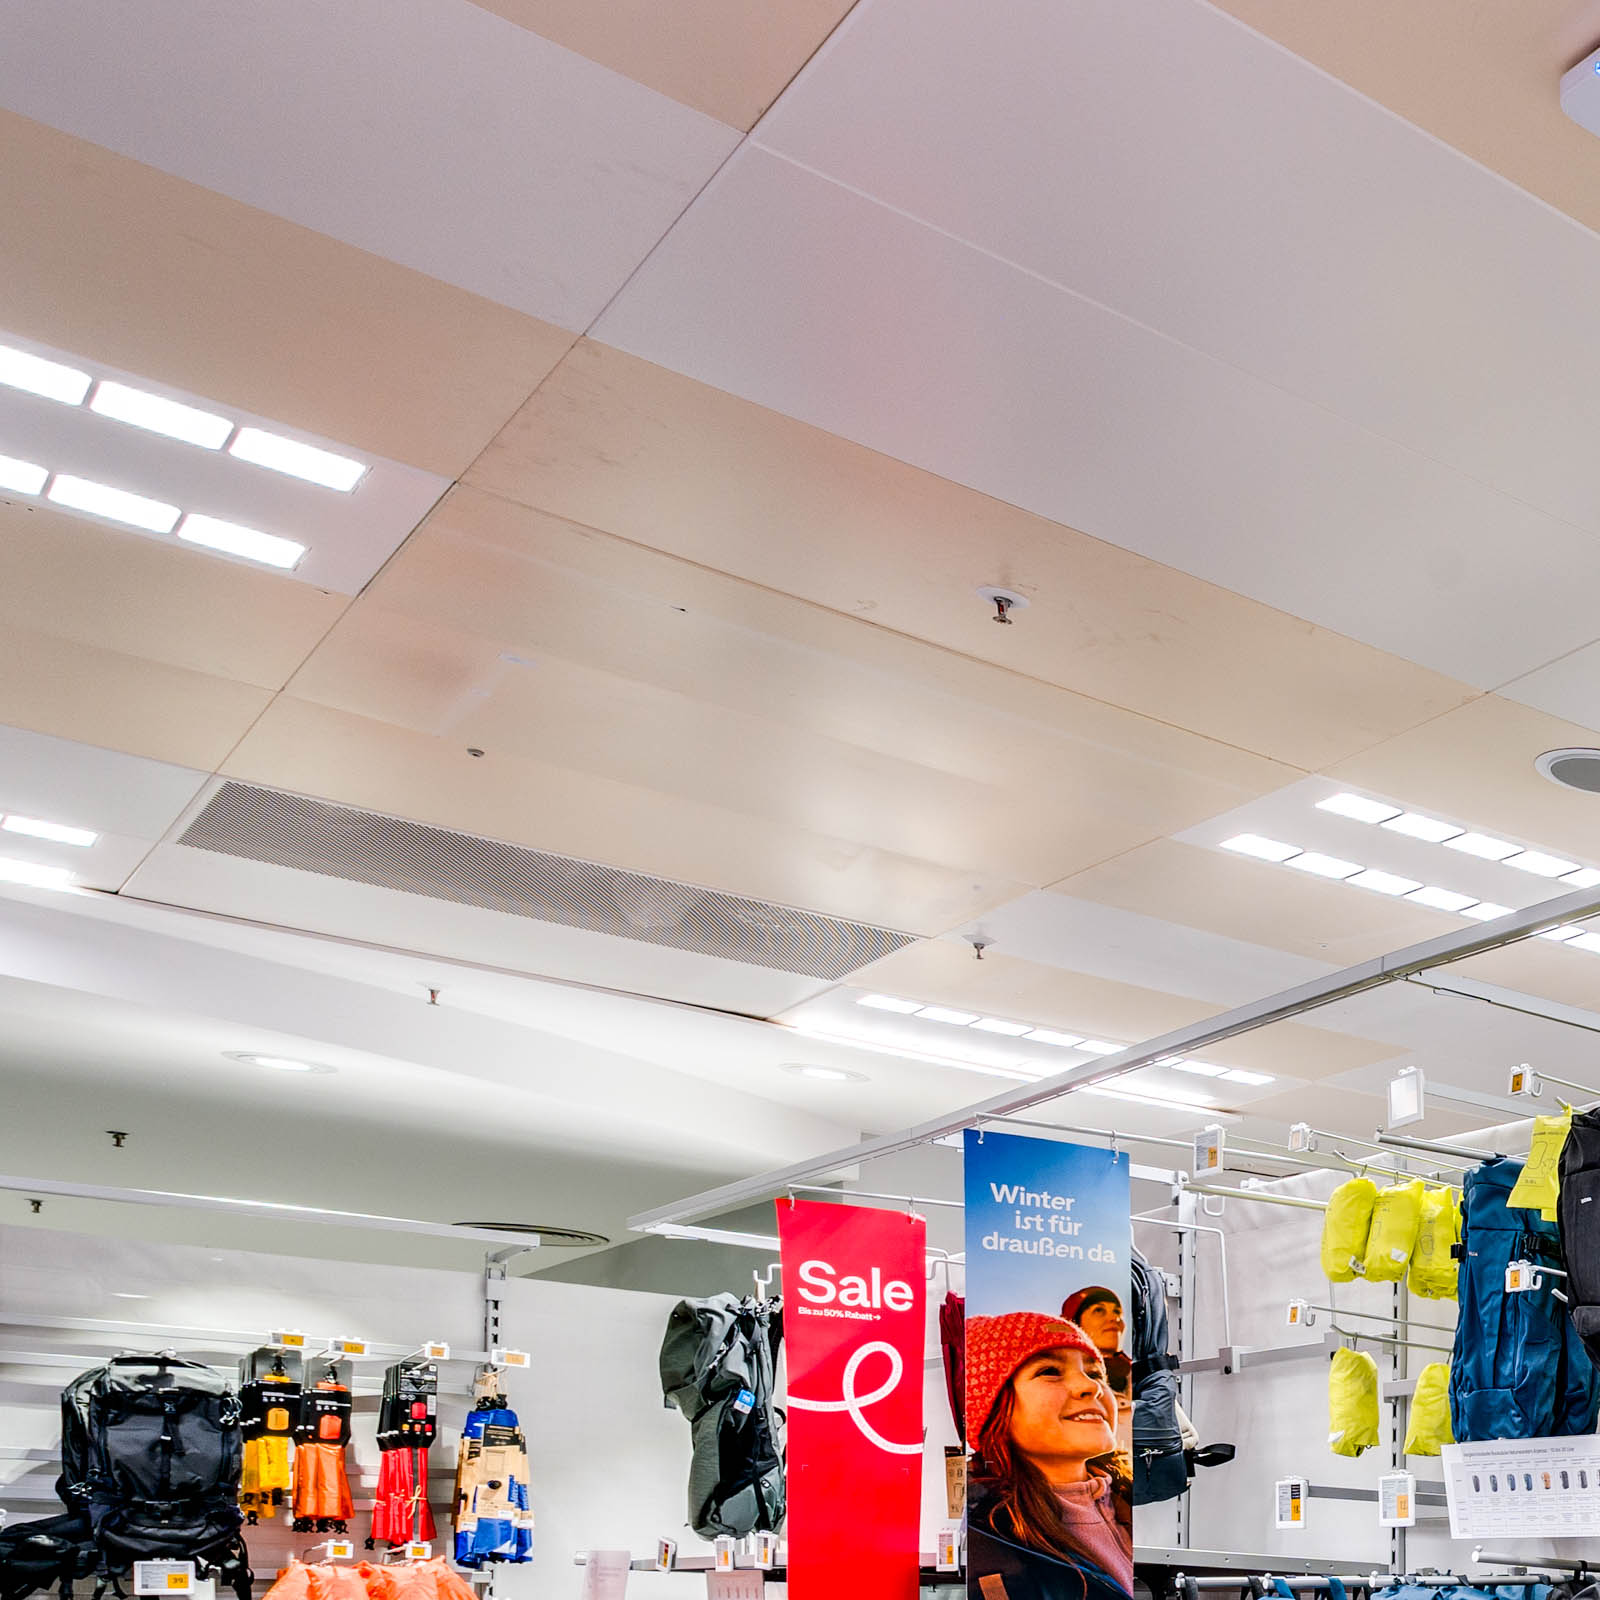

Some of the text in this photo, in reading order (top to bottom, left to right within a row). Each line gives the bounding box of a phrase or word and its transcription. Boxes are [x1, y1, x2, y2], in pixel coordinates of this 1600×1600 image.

[990, 1182, 1076, 1211] Winter
[1015, 1210, 1083, 1236] ist für
[981, 1231, 1116, 1264] draußen da
[797, 1260, 914, 1311] Sale
[798, 1306, 872, 1320] Bis zu 50% Rabatt
